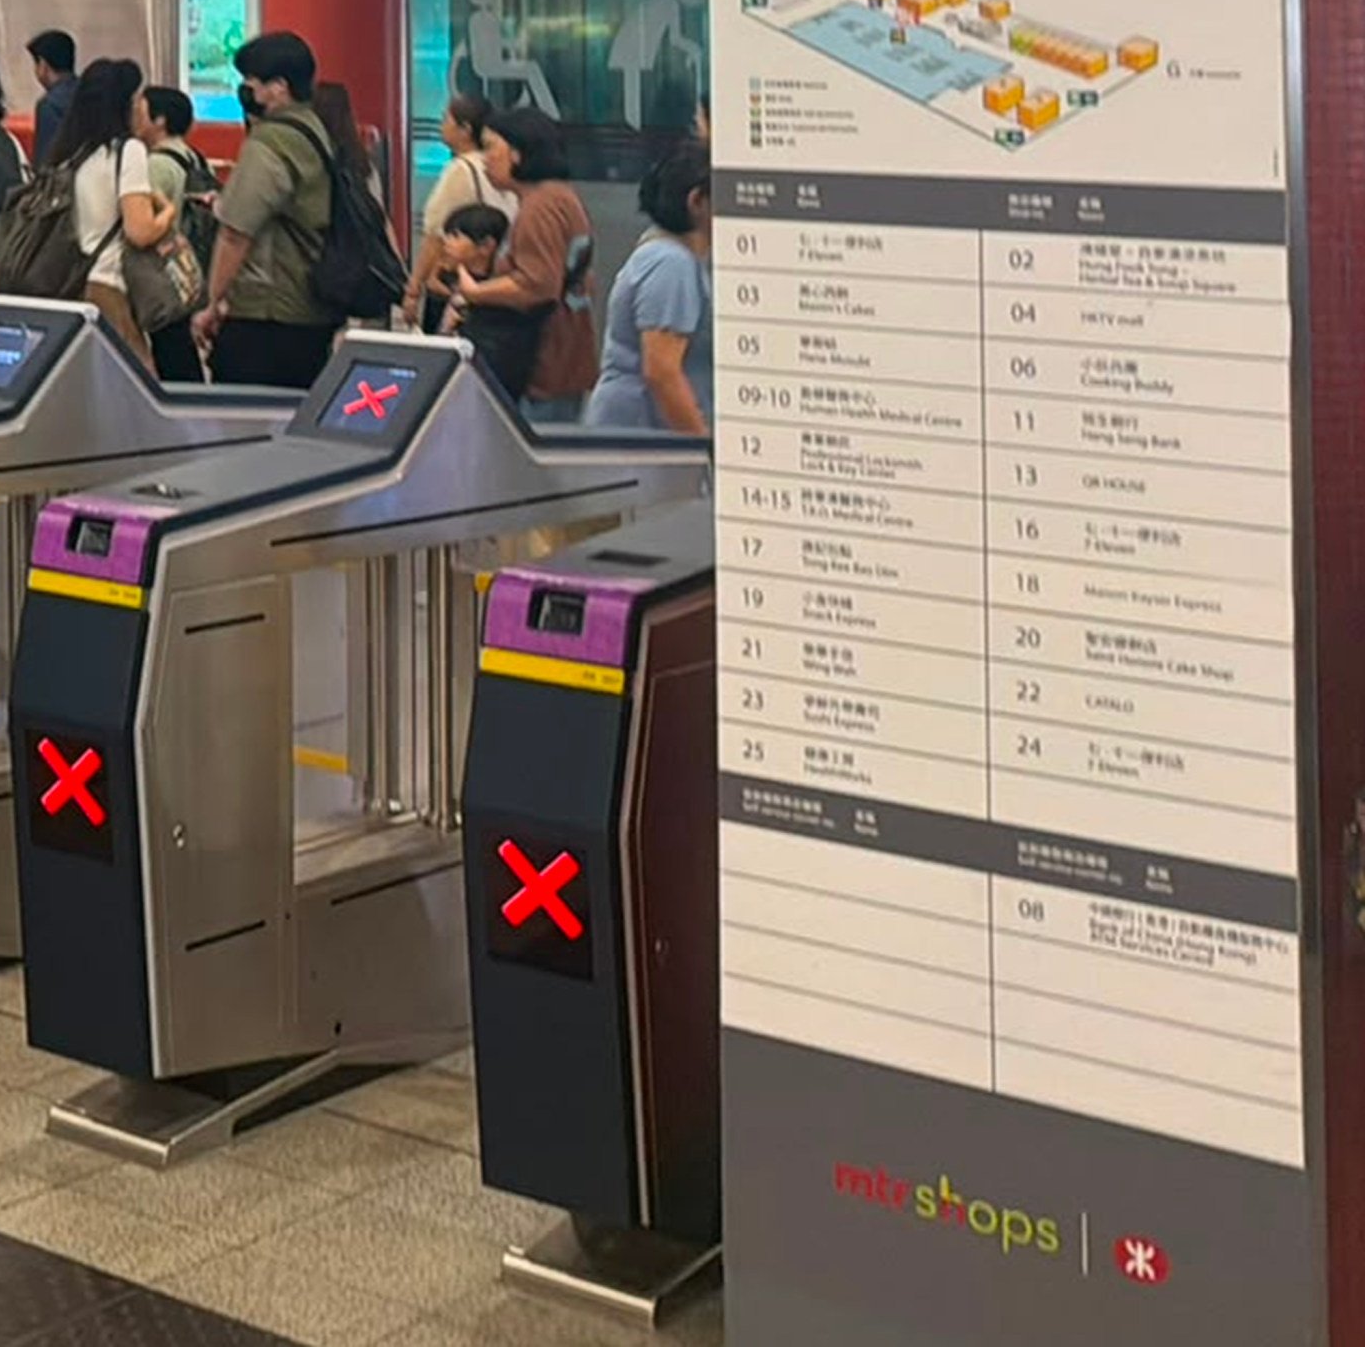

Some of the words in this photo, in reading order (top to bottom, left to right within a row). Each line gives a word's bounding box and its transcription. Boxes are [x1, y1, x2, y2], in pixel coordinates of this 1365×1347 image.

[736, 234, 757, 254] 01
[1009, 250, 1034, 271] 02
[737, 285, 760, 305] 03
[1011, 303, 1036, 323] 04
[738, 335, 760, 355] 05
[1011, 357, 1036, 378] 06
[738, 385, 791, 409] 09-10
[1014, 411, 1035, 432] 11
[740, 436, 761, 456] 12
[1014, 464, 1038, 486] 13
[740, 487, 791, 510] 14-15
[1014, 519, 1039, 540] 16
[742, 537, 763, 557] 17
[1015, 573, 1039, 594] 18
[742, 588, 764, 608] 19
[1015, 626, 1041, 648] 20
[741, 639, 762, 659] 21
[742, 690, 764, 711] 23
[1016, 682, 1041, 702] 22
[742, 740, 764, 761] 25
[1016, 736, 1042, 756] 24
[1018, 899, 1045, 922] 08
